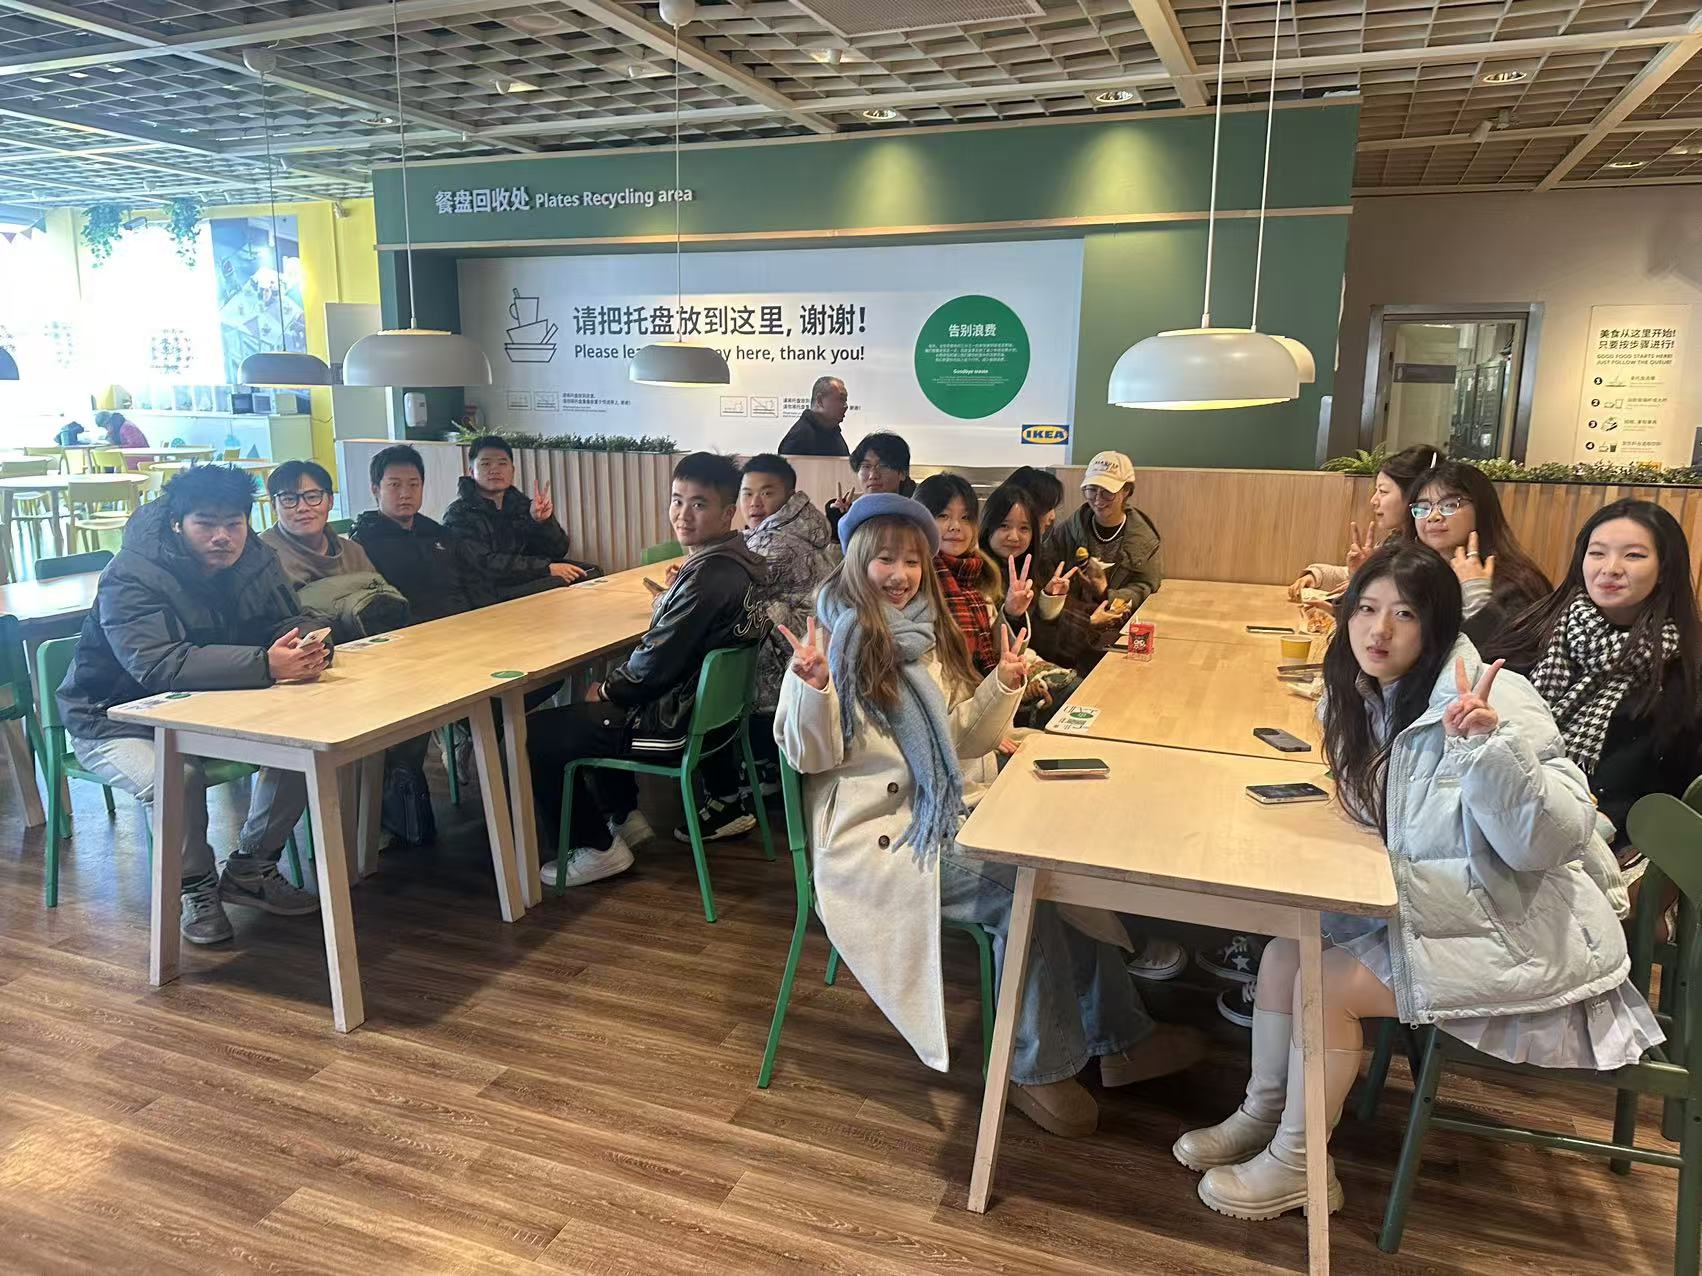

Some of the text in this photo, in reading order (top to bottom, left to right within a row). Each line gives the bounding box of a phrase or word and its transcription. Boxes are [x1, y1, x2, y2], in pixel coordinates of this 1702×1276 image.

[434, 186, 693, 215] 餐盘回收处 Plates Recycling area
[949, 323, 998, 338] 告别浪费
[574, 343, 619, 359] Please
[736, 345, 775, 363] here,
[780, 345, 826, 361] thank
[831, 345, 865, 365] you!
[1026, 430, 1065, 439] IKEA
